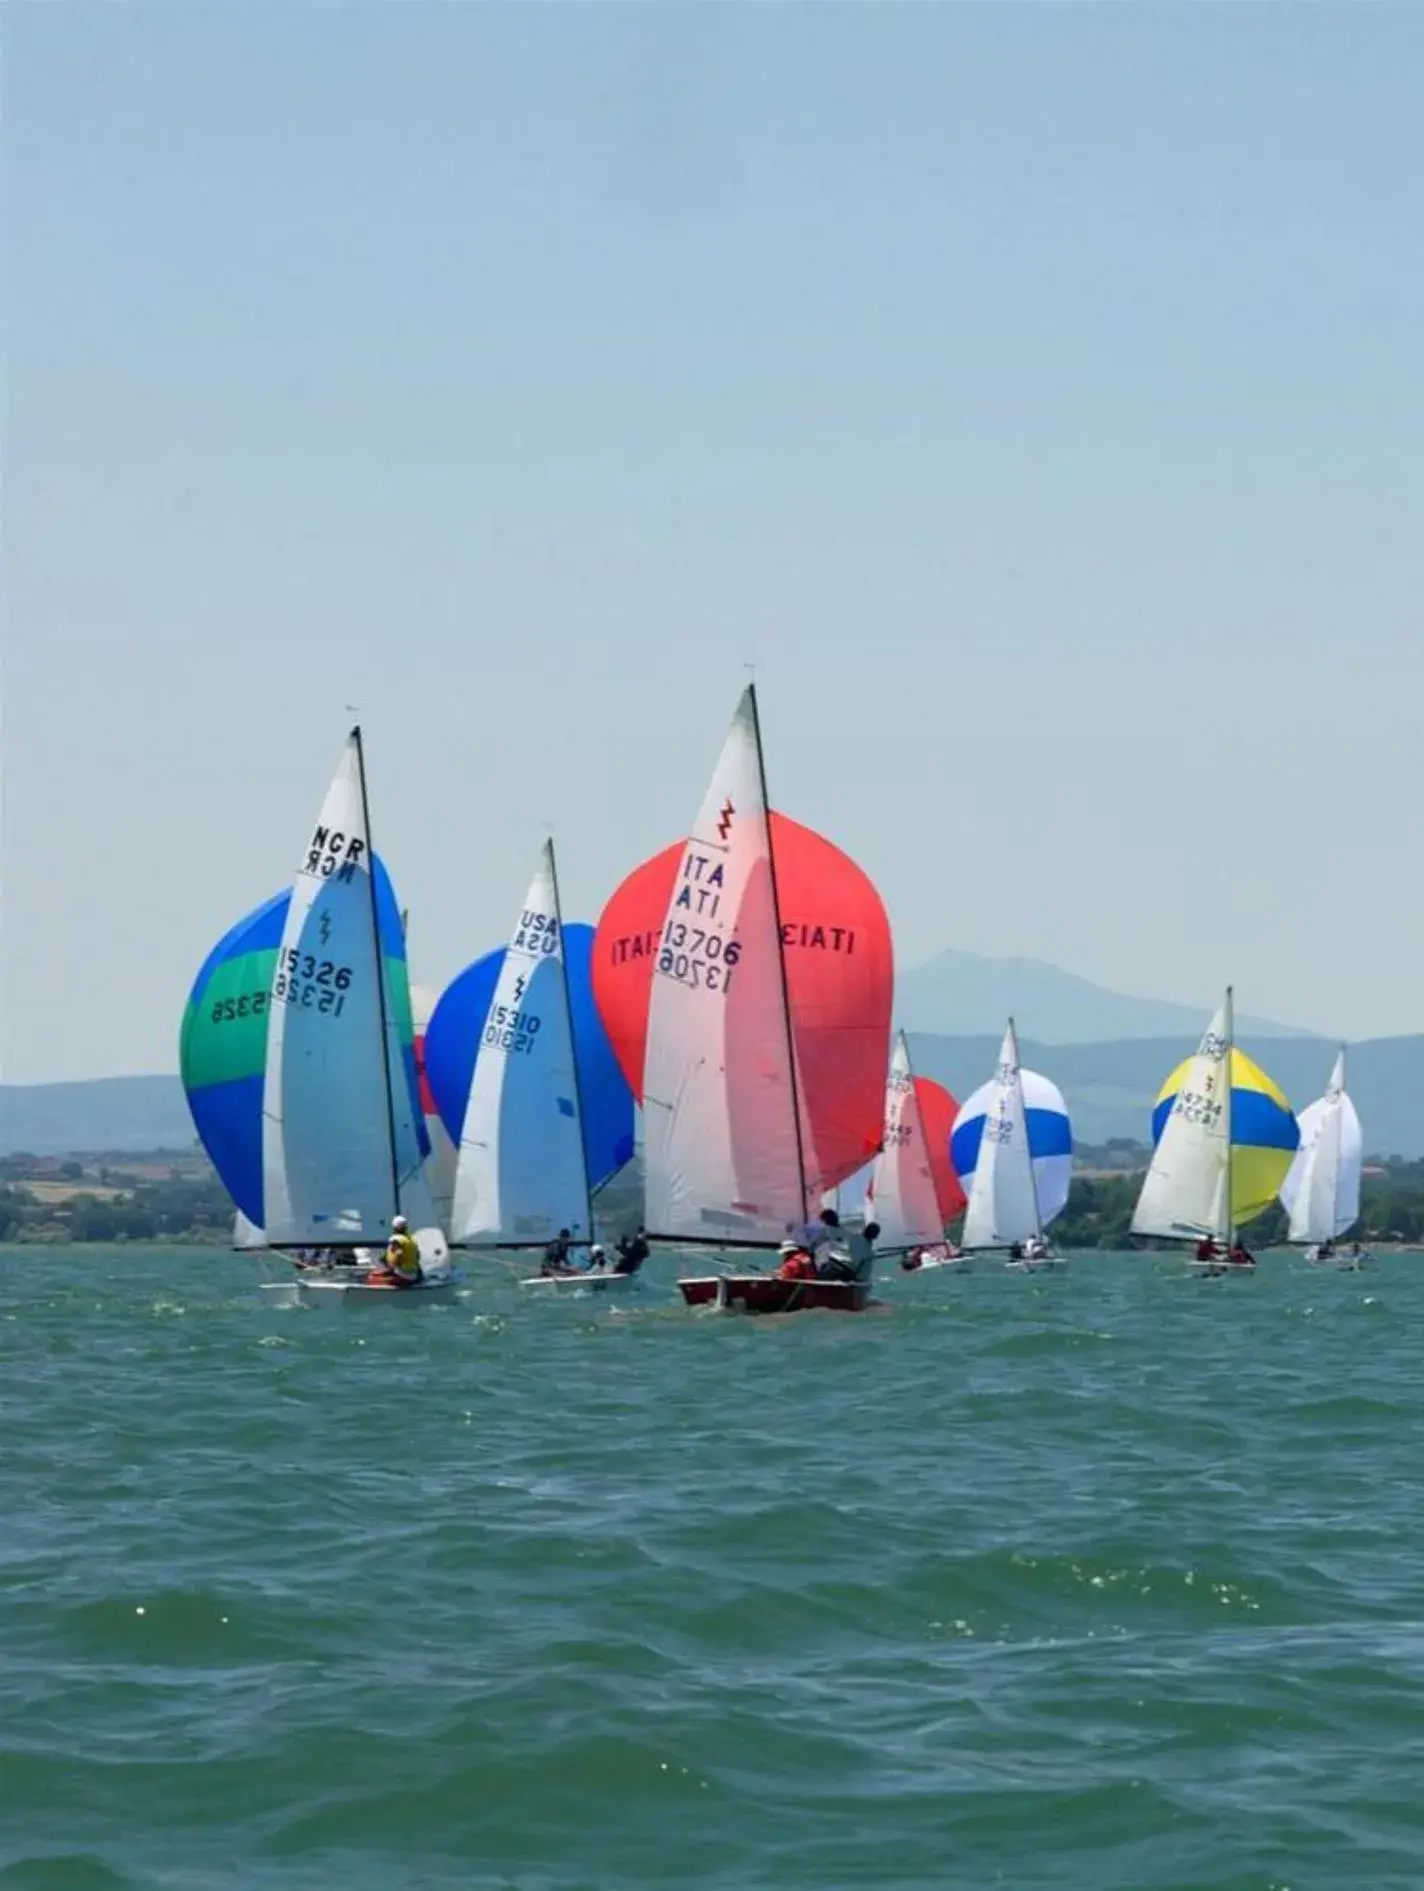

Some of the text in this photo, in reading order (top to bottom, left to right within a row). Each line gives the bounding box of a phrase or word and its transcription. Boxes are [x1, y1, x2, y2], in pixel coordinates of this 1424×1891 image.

[684, 854, 723, 888] ITA
[521, 911, 557, 936] USA
[665, 920, 742, 965] 13706
[279, 946, 352, 990] 15326
[491, 1004, 541, 1033] 15310
